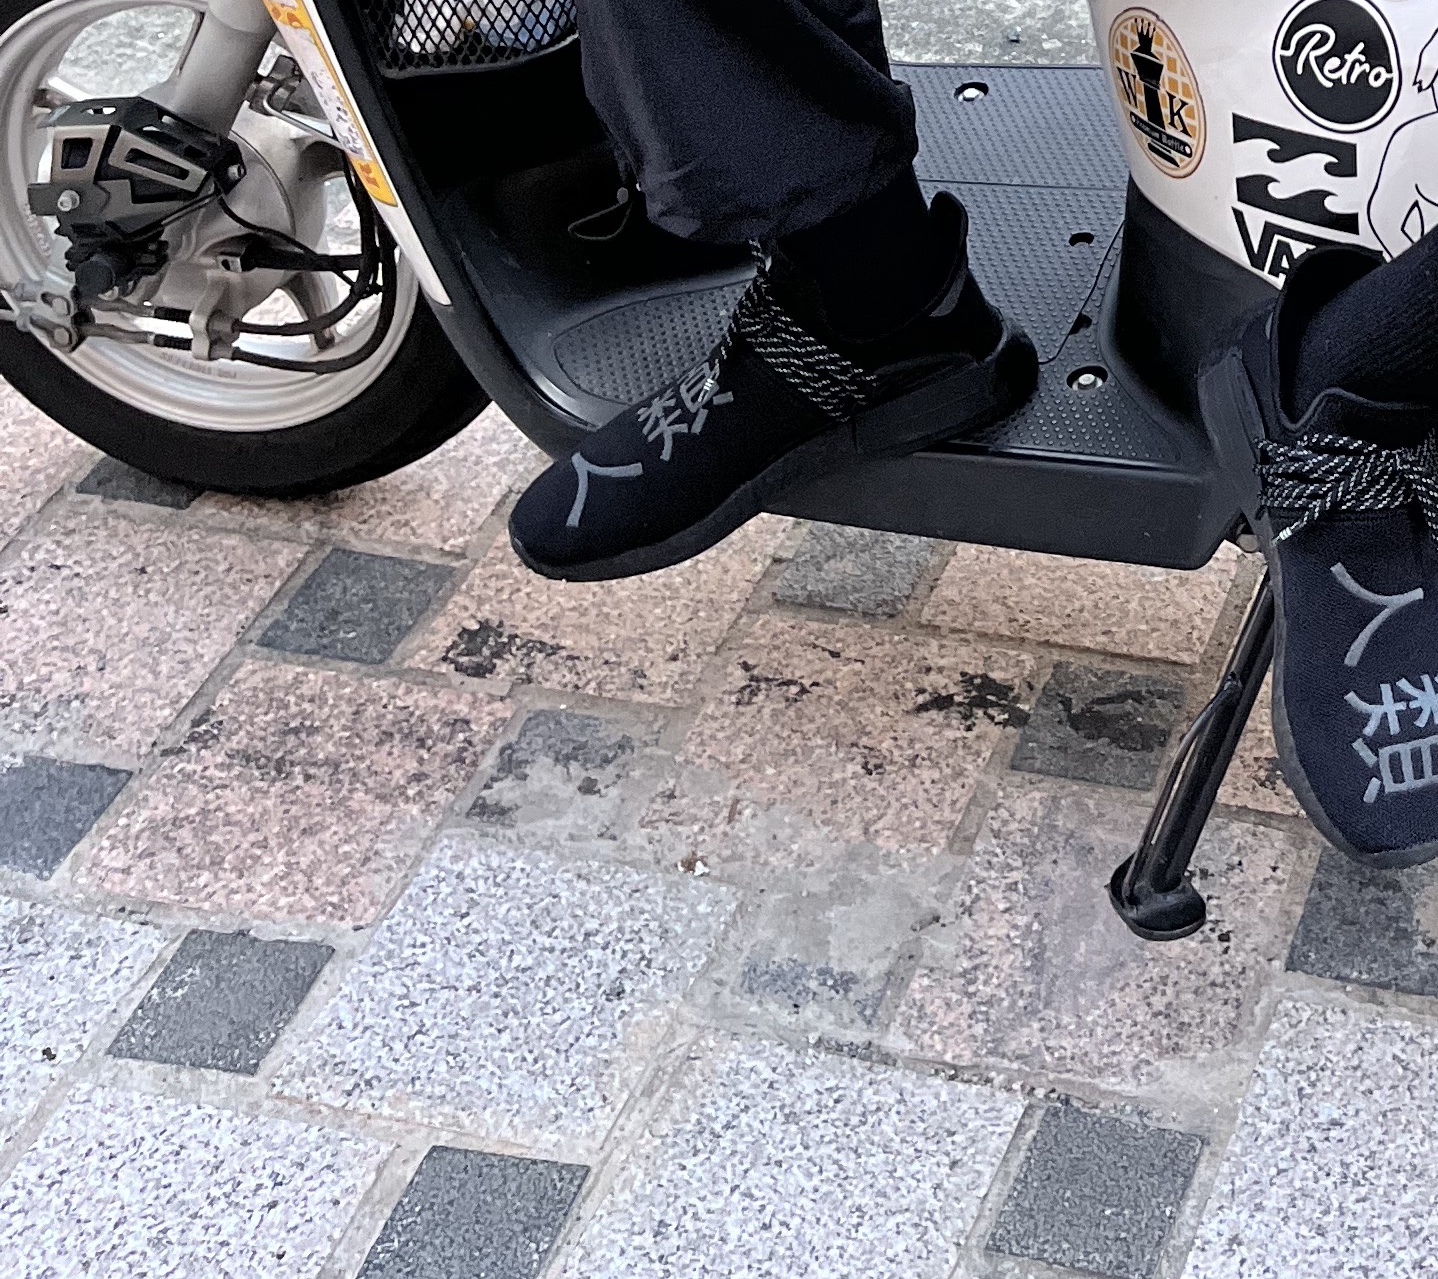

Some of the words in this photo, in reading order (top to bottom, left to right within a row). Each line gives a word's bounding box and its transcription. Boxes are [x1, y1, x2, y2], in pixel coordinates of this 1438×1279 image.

[1283, 23, 1393, 88] Retro
[1116, 66, 1138, 109] W
[1165, 90, 1193, 138] K
